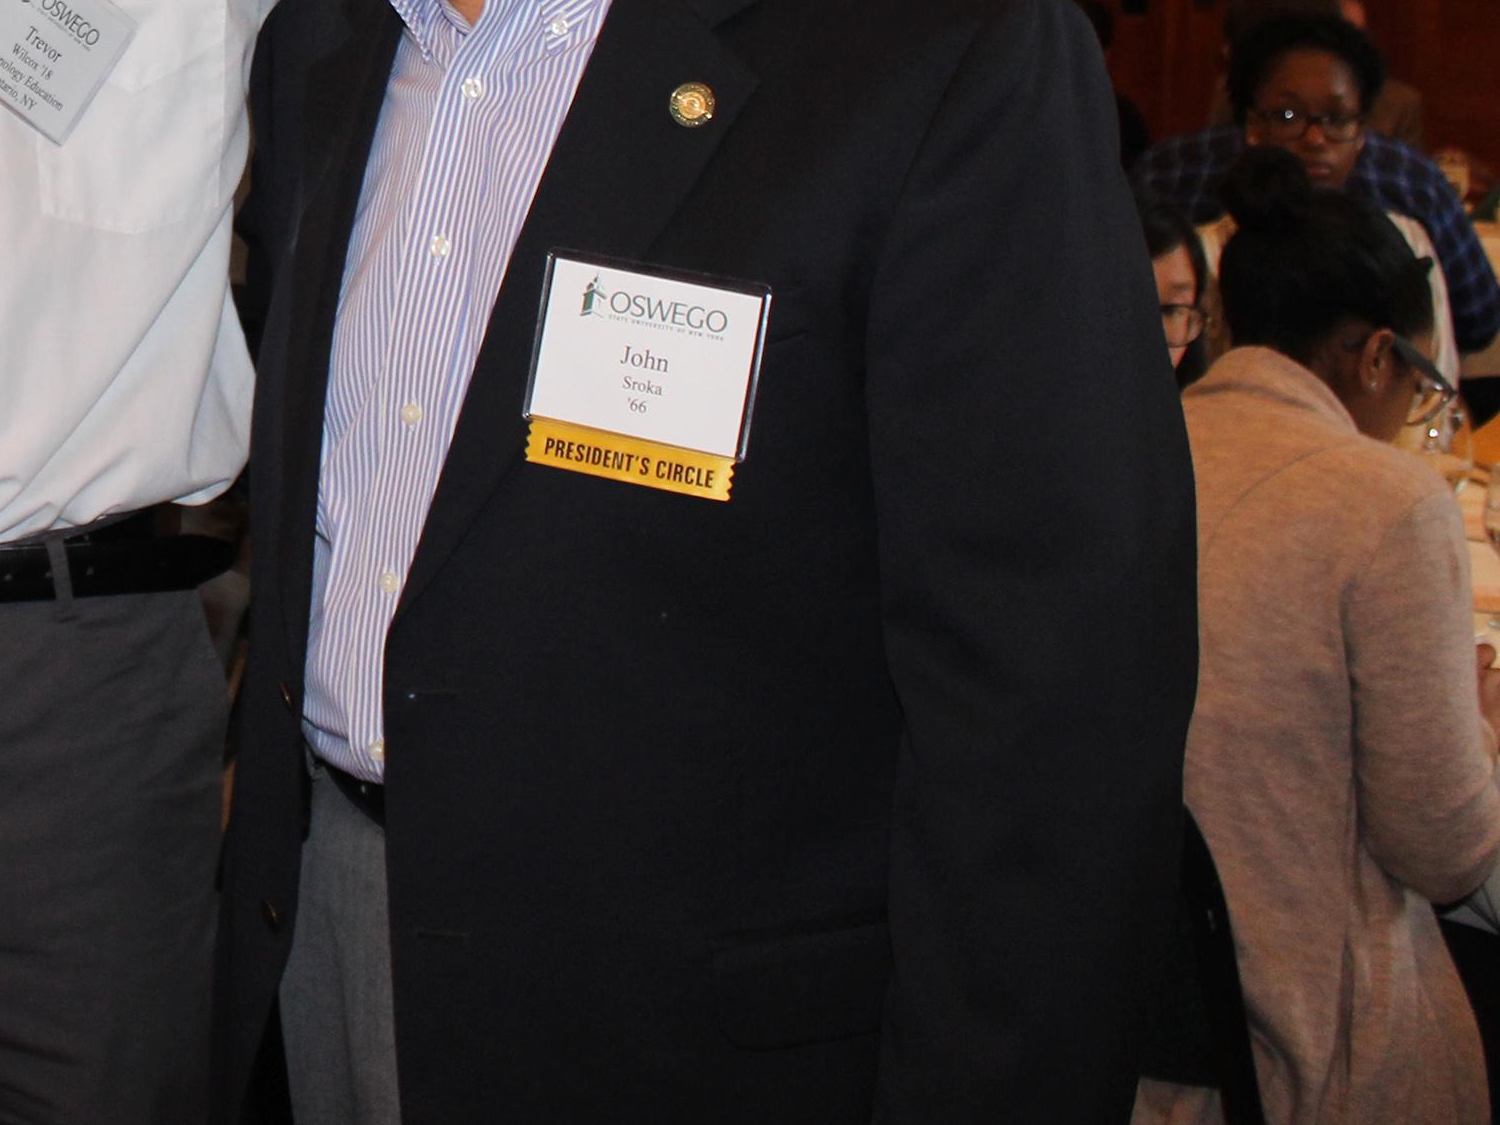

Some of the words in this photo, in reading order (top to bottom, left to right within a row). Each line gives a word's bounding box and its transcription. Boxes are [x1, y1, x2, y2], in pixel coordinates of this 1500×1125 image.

[12, 42, 39, 71] Wilcox
[41, 64, 55, 80] '18
[25, 26, 63, 63] Trevor
[22, 93, 39, 111] NY
[24, 76, 64, 112] Education
[610, 291, 728, 333] OSWEGO
[620, 346, 669, 373] John
[622, 375, 663, 396] Sroka
[627, 398, 648, 414] '66
[544, 437, 650, 476] PRESIDENT'S
[656, 462, 715, 489] CIRCLE
